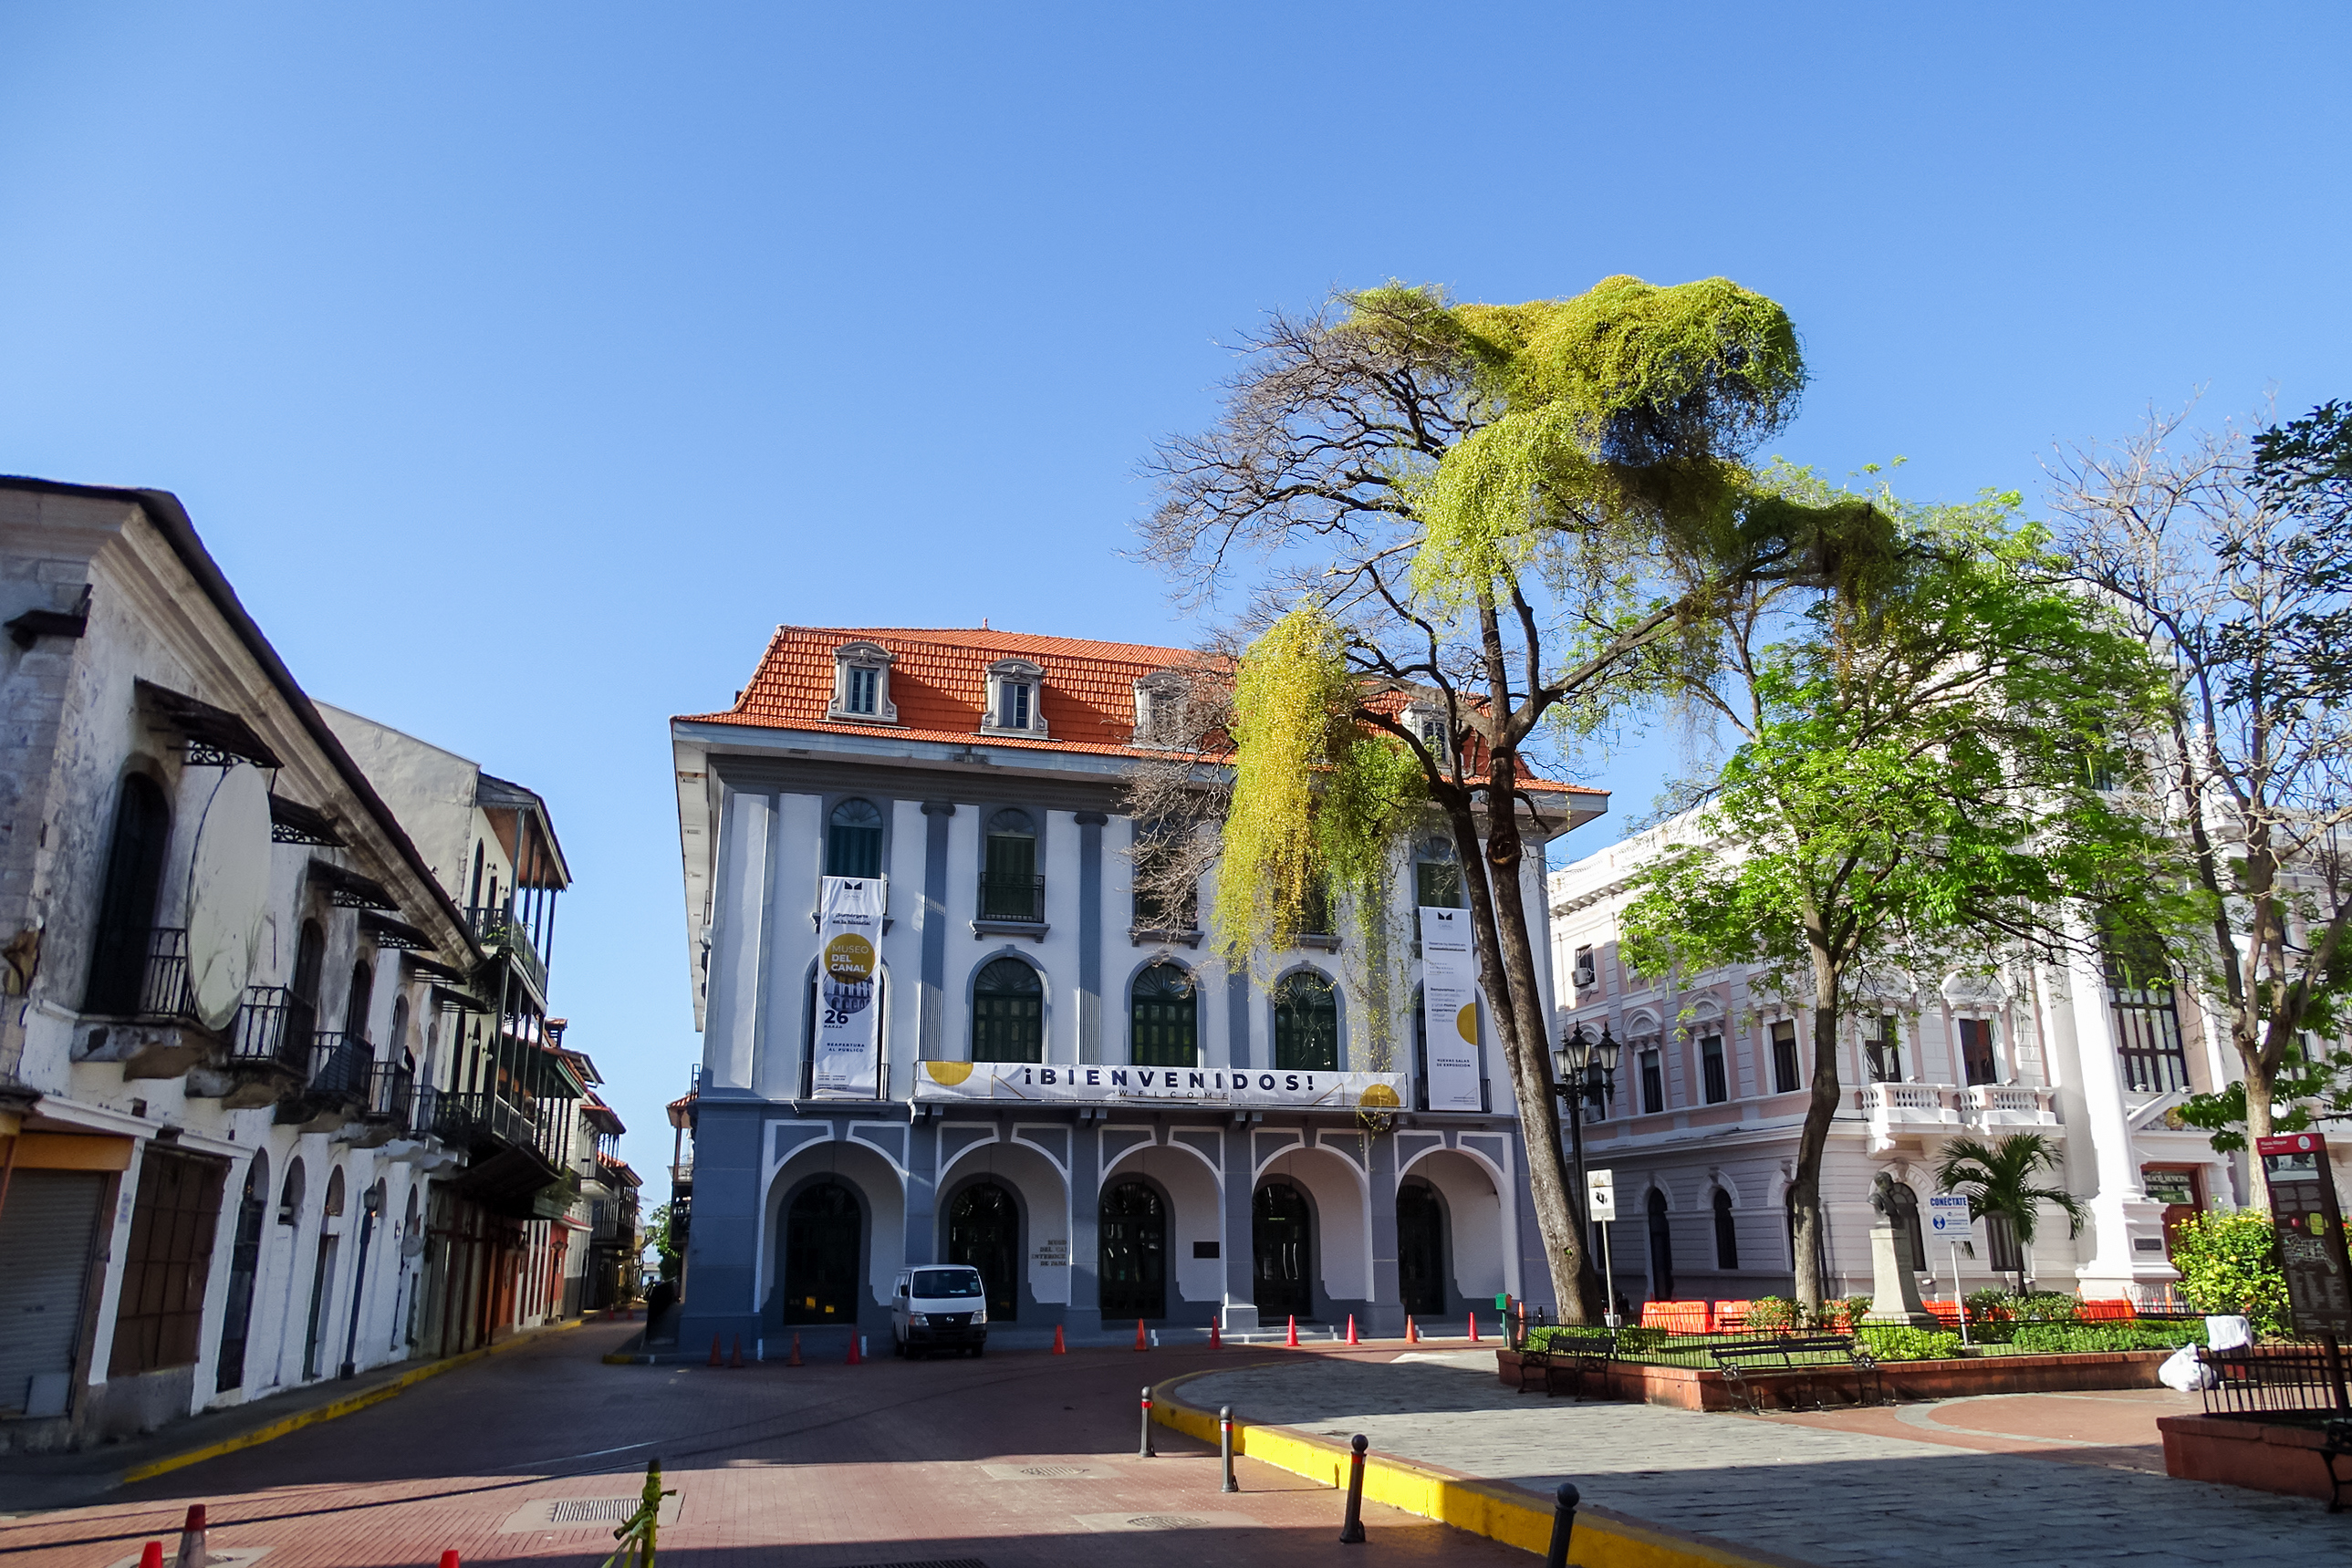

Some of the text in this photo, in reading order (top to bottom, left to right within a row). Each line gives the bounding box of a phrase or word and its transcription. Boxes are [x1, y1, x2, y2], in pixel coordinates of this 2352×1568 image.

[832, 945, 869, 954] MUSEO
[831, 954, 852, 962] DEL
[831, 963, 867, 972] CANAL
[824, 1009, 848, 1024] 26
[1025, 1068, 1314, 1091] ¡BIENVENIDOS!
[1119, 1089, 1228, 1099] WELCOME
[1930, 1197, 1967, 1206] CONÉCTATE
